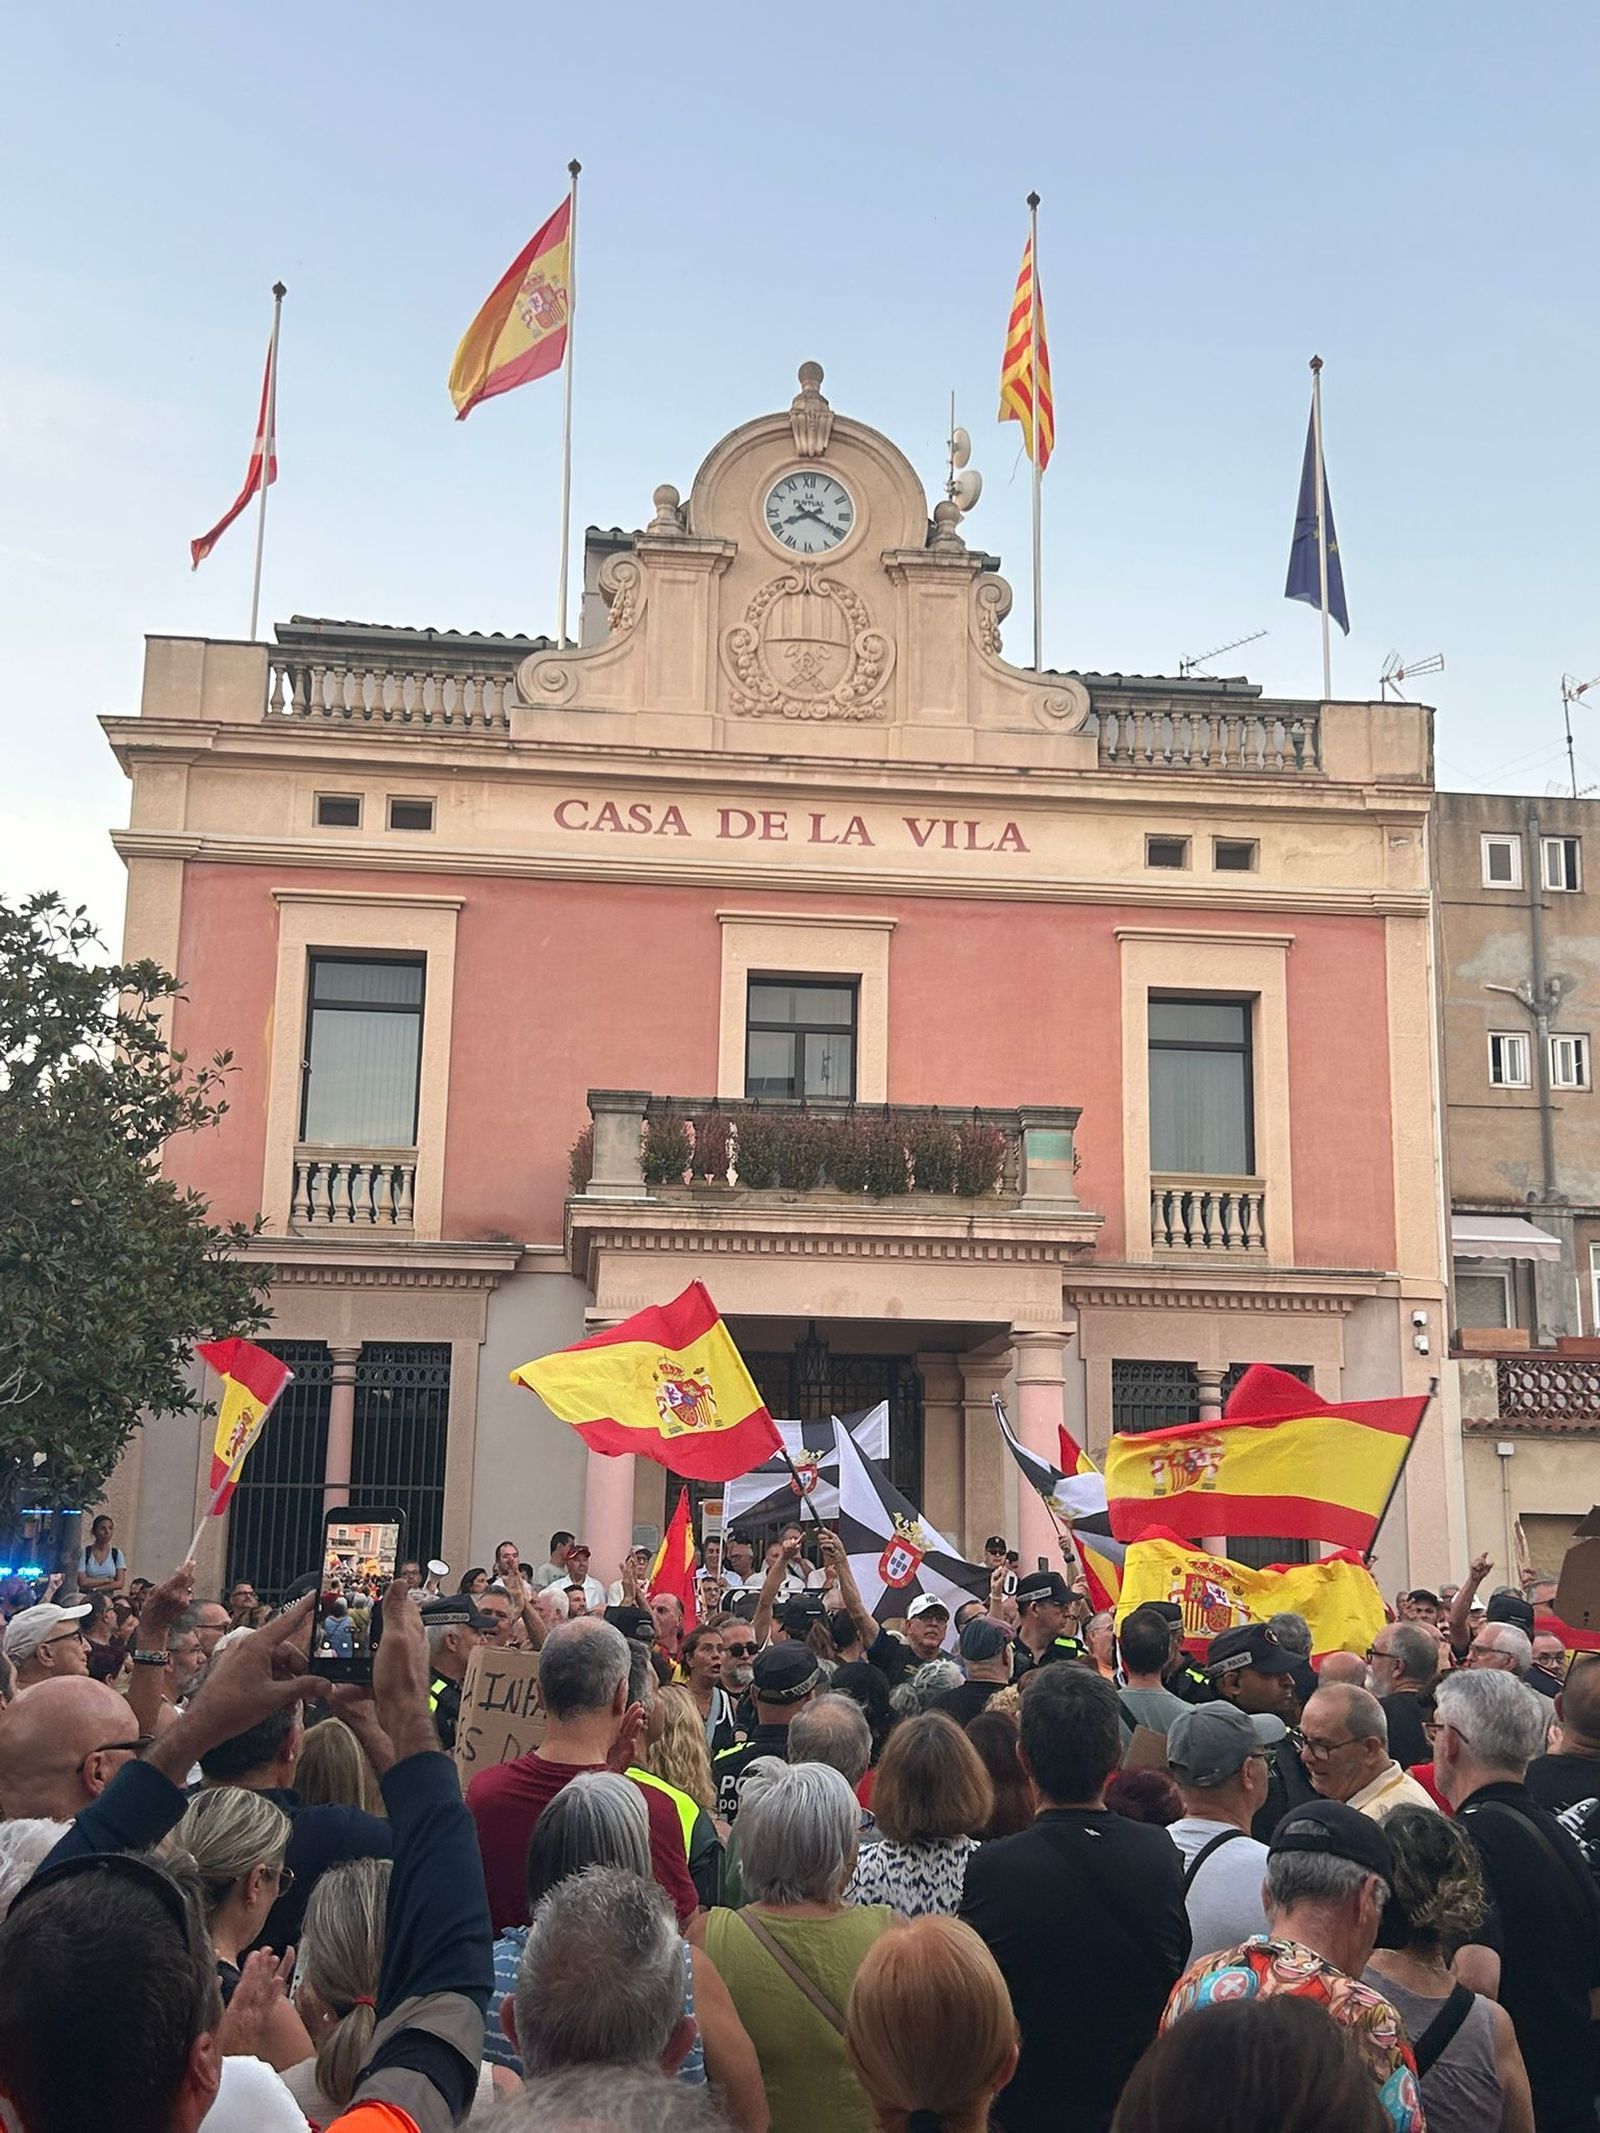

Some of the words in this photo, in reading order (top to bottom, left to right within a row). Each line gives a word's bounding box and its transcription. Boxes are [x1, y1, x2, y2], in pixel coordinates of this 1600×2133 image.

[554, 800, 691, 836] CASA
[716, 808, 788, 841] DE
[808, 813, 875, 846] LA
[902, 817, 1031, 852] VILA
